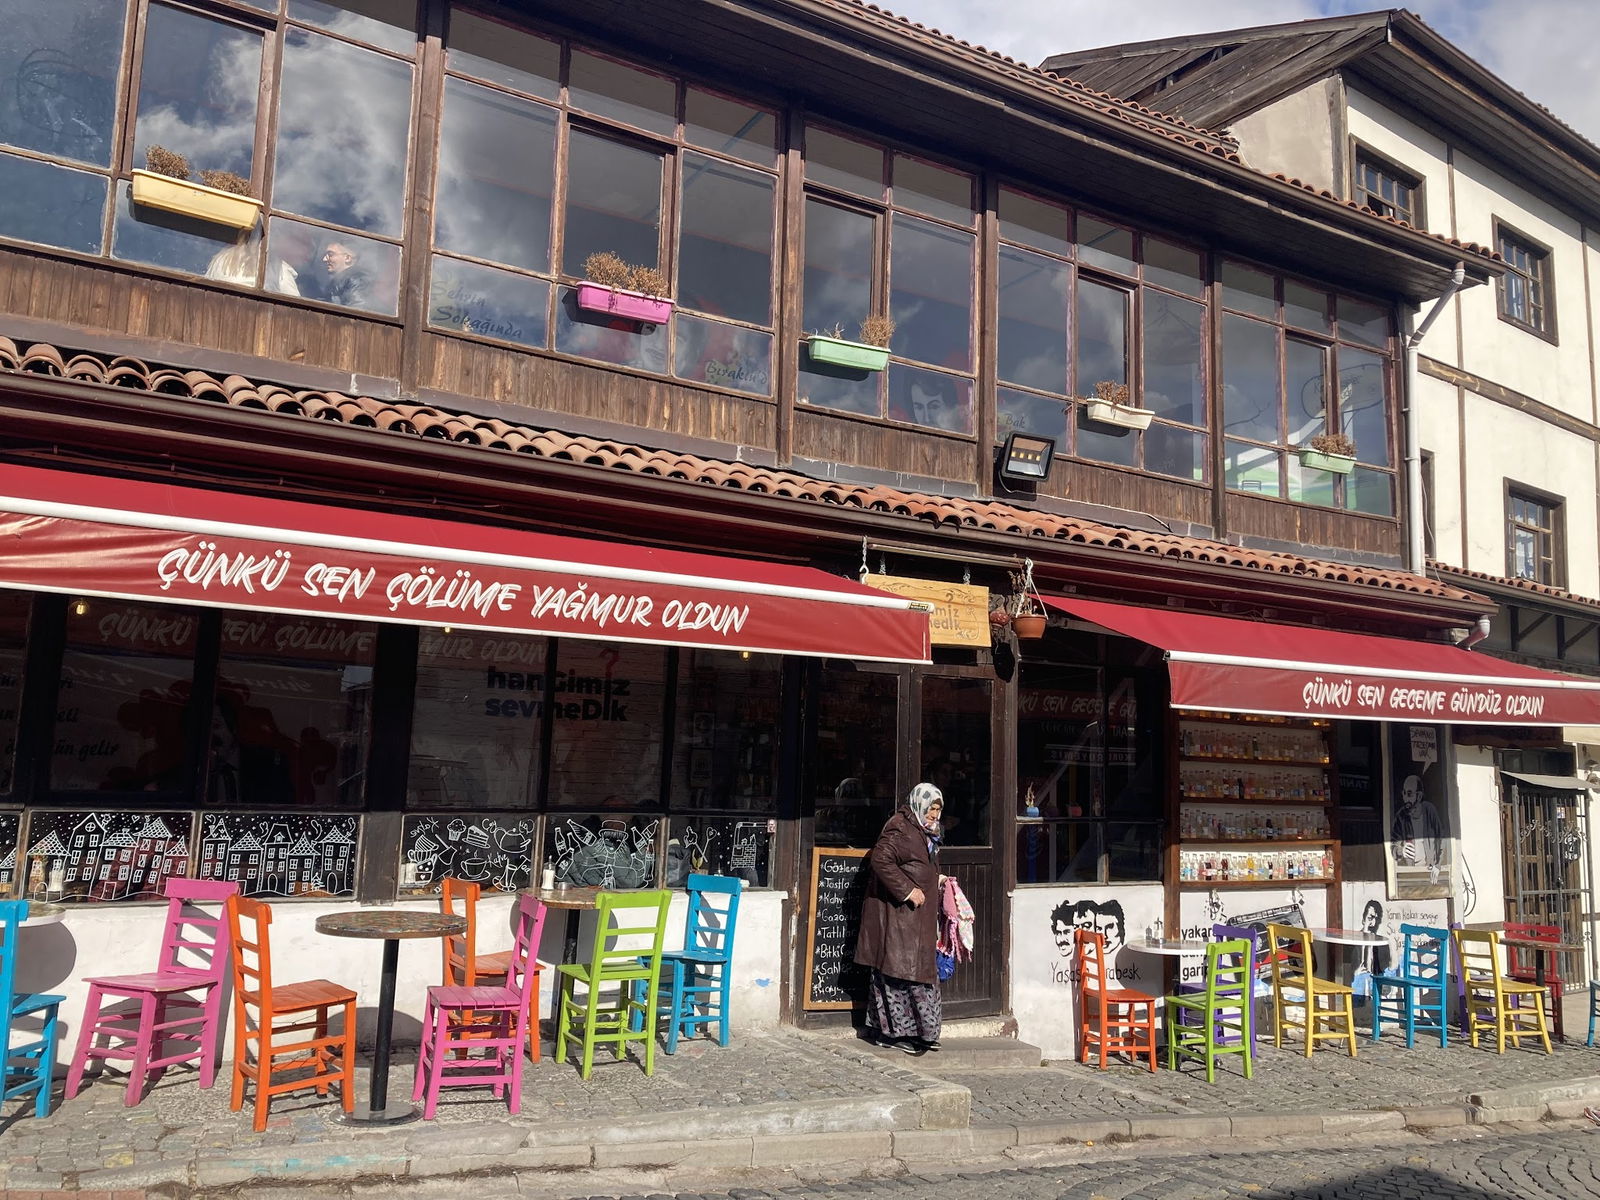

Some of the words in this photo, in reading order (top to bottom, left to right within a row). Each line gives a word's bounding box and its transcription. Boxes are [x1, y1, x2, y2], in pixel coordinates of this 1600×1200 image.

[1004, 413, 1026, 429] Bak
[157, 540, 292, 595] ÇÜNKÜ
[300, 562, 377, 603] SEN
[385, 565, 522, 619] ÇÖLÜME
[531, 581, 653, 629] YAĞMUR
[660, 599, 750, 637] OLDUN
[1302, 677, 1353, 709] ÇÜNKÜ
[1356, 685, 1385, 710] SEN
[1389, 687, 1447, 716] GECEME
[1450, 686, 1503, 716] GÜNDÜZ
[1505, 694, 1545, 718] OLDUN
[1105, 961, 1142, 981] rabesk
